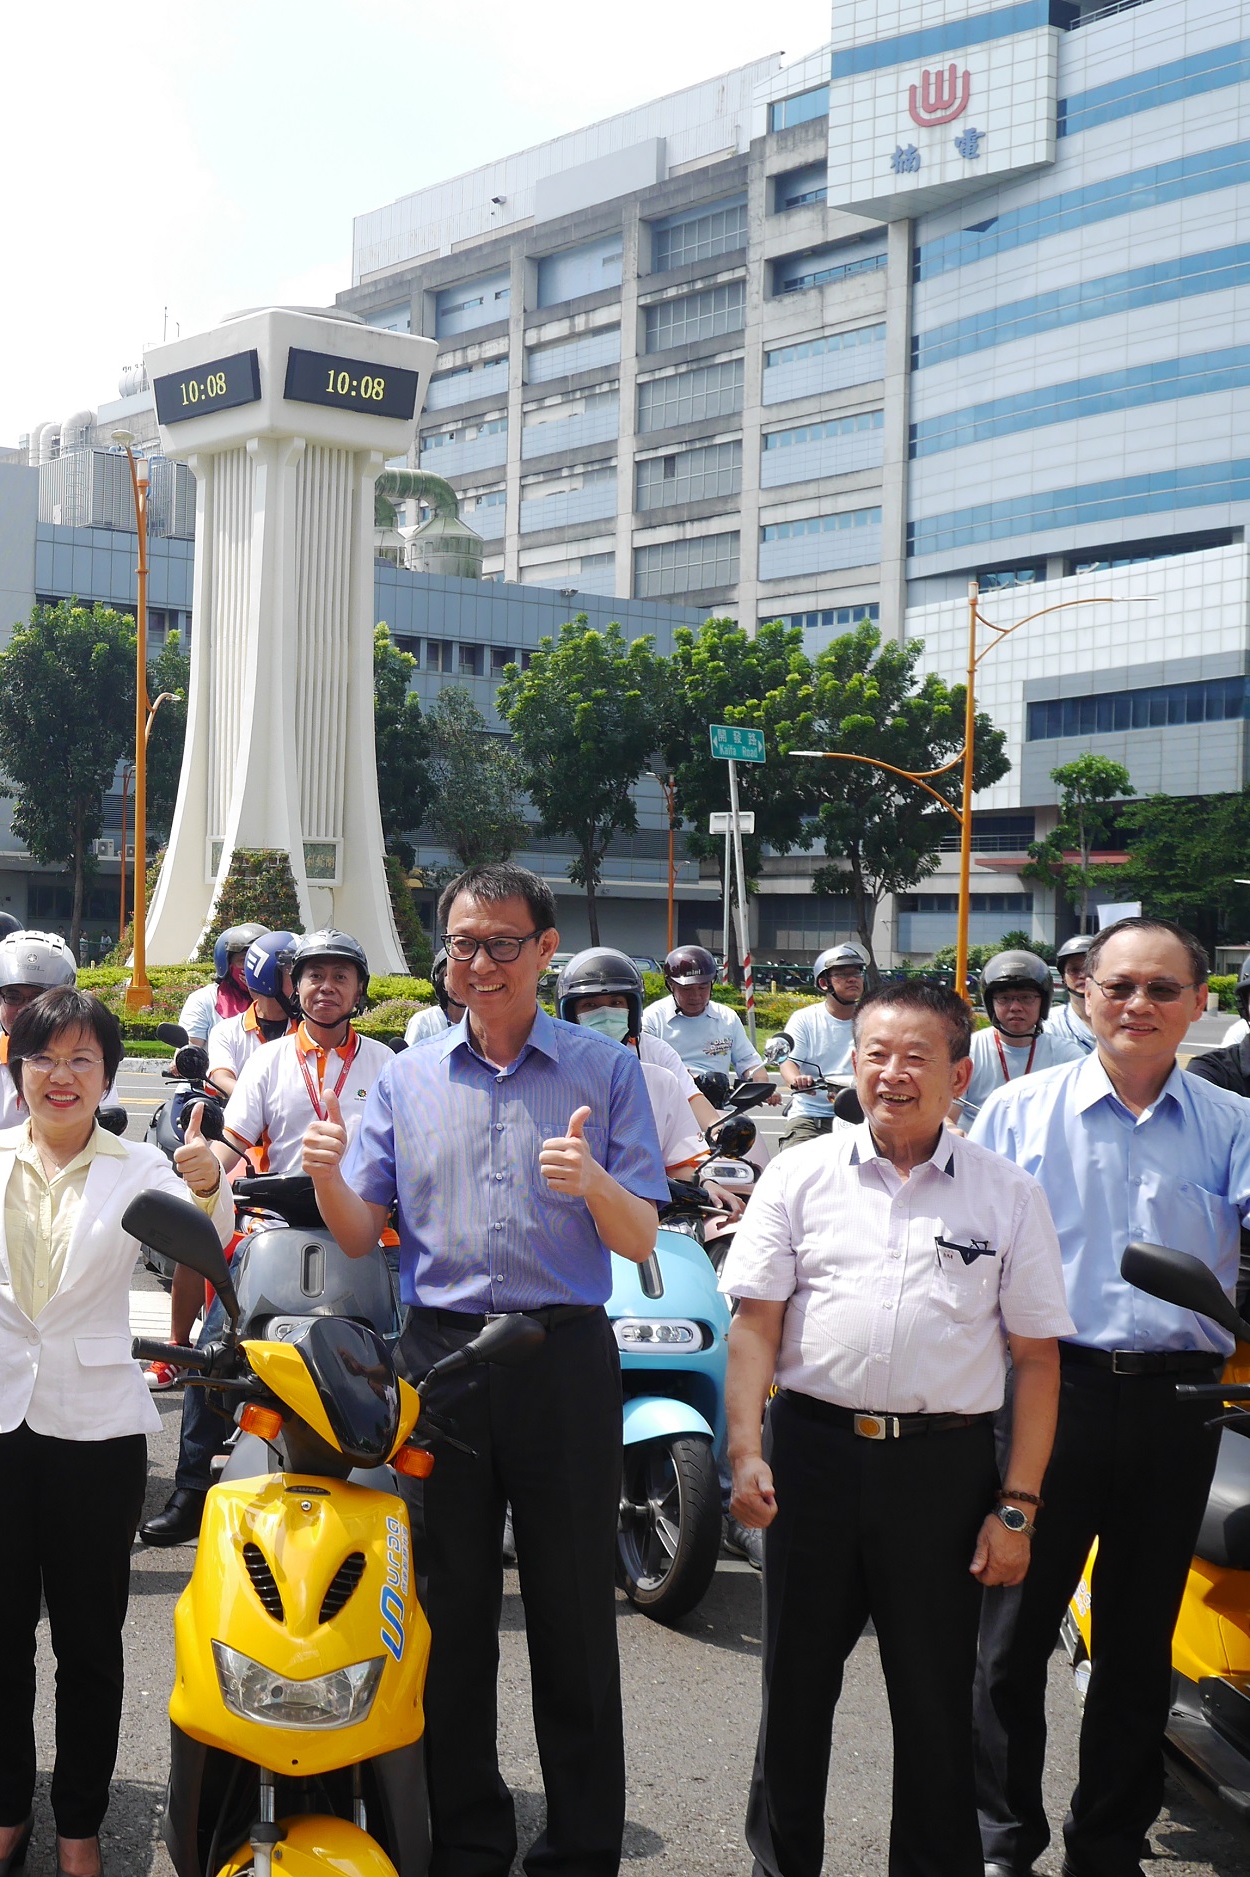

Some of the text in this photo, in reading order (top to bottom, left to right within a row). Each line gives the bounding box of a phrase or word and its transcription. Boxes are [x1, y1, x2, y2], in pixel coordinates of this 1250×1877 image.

[180, 371, 227, 406] 10:08
[325, 369, 385, 401] 10:08
[719, 743, 758, 758] Kaifa Road
